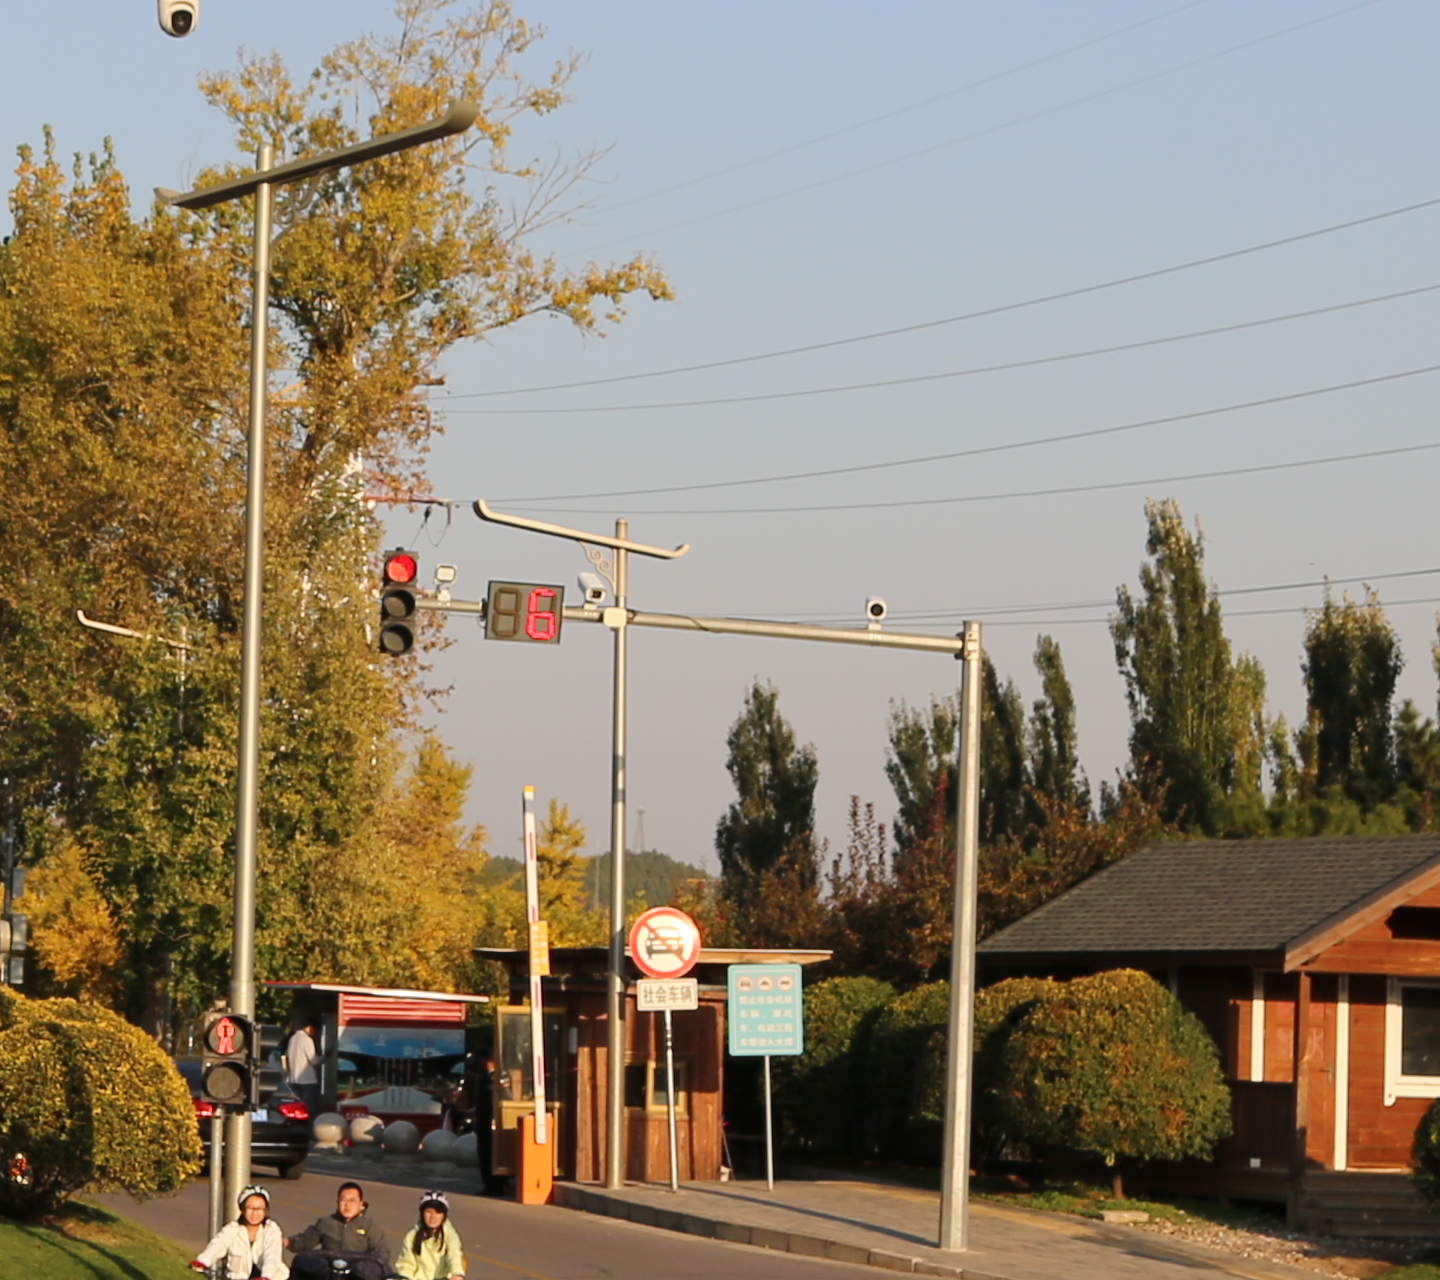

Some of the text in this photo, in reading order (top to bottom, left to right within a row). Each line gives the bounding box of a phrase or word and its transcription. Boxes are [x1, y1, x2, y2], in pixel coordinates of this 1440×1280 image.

[525, 587, 557, 641] 6
[643, 985, 693, 1004] 社会车辆
